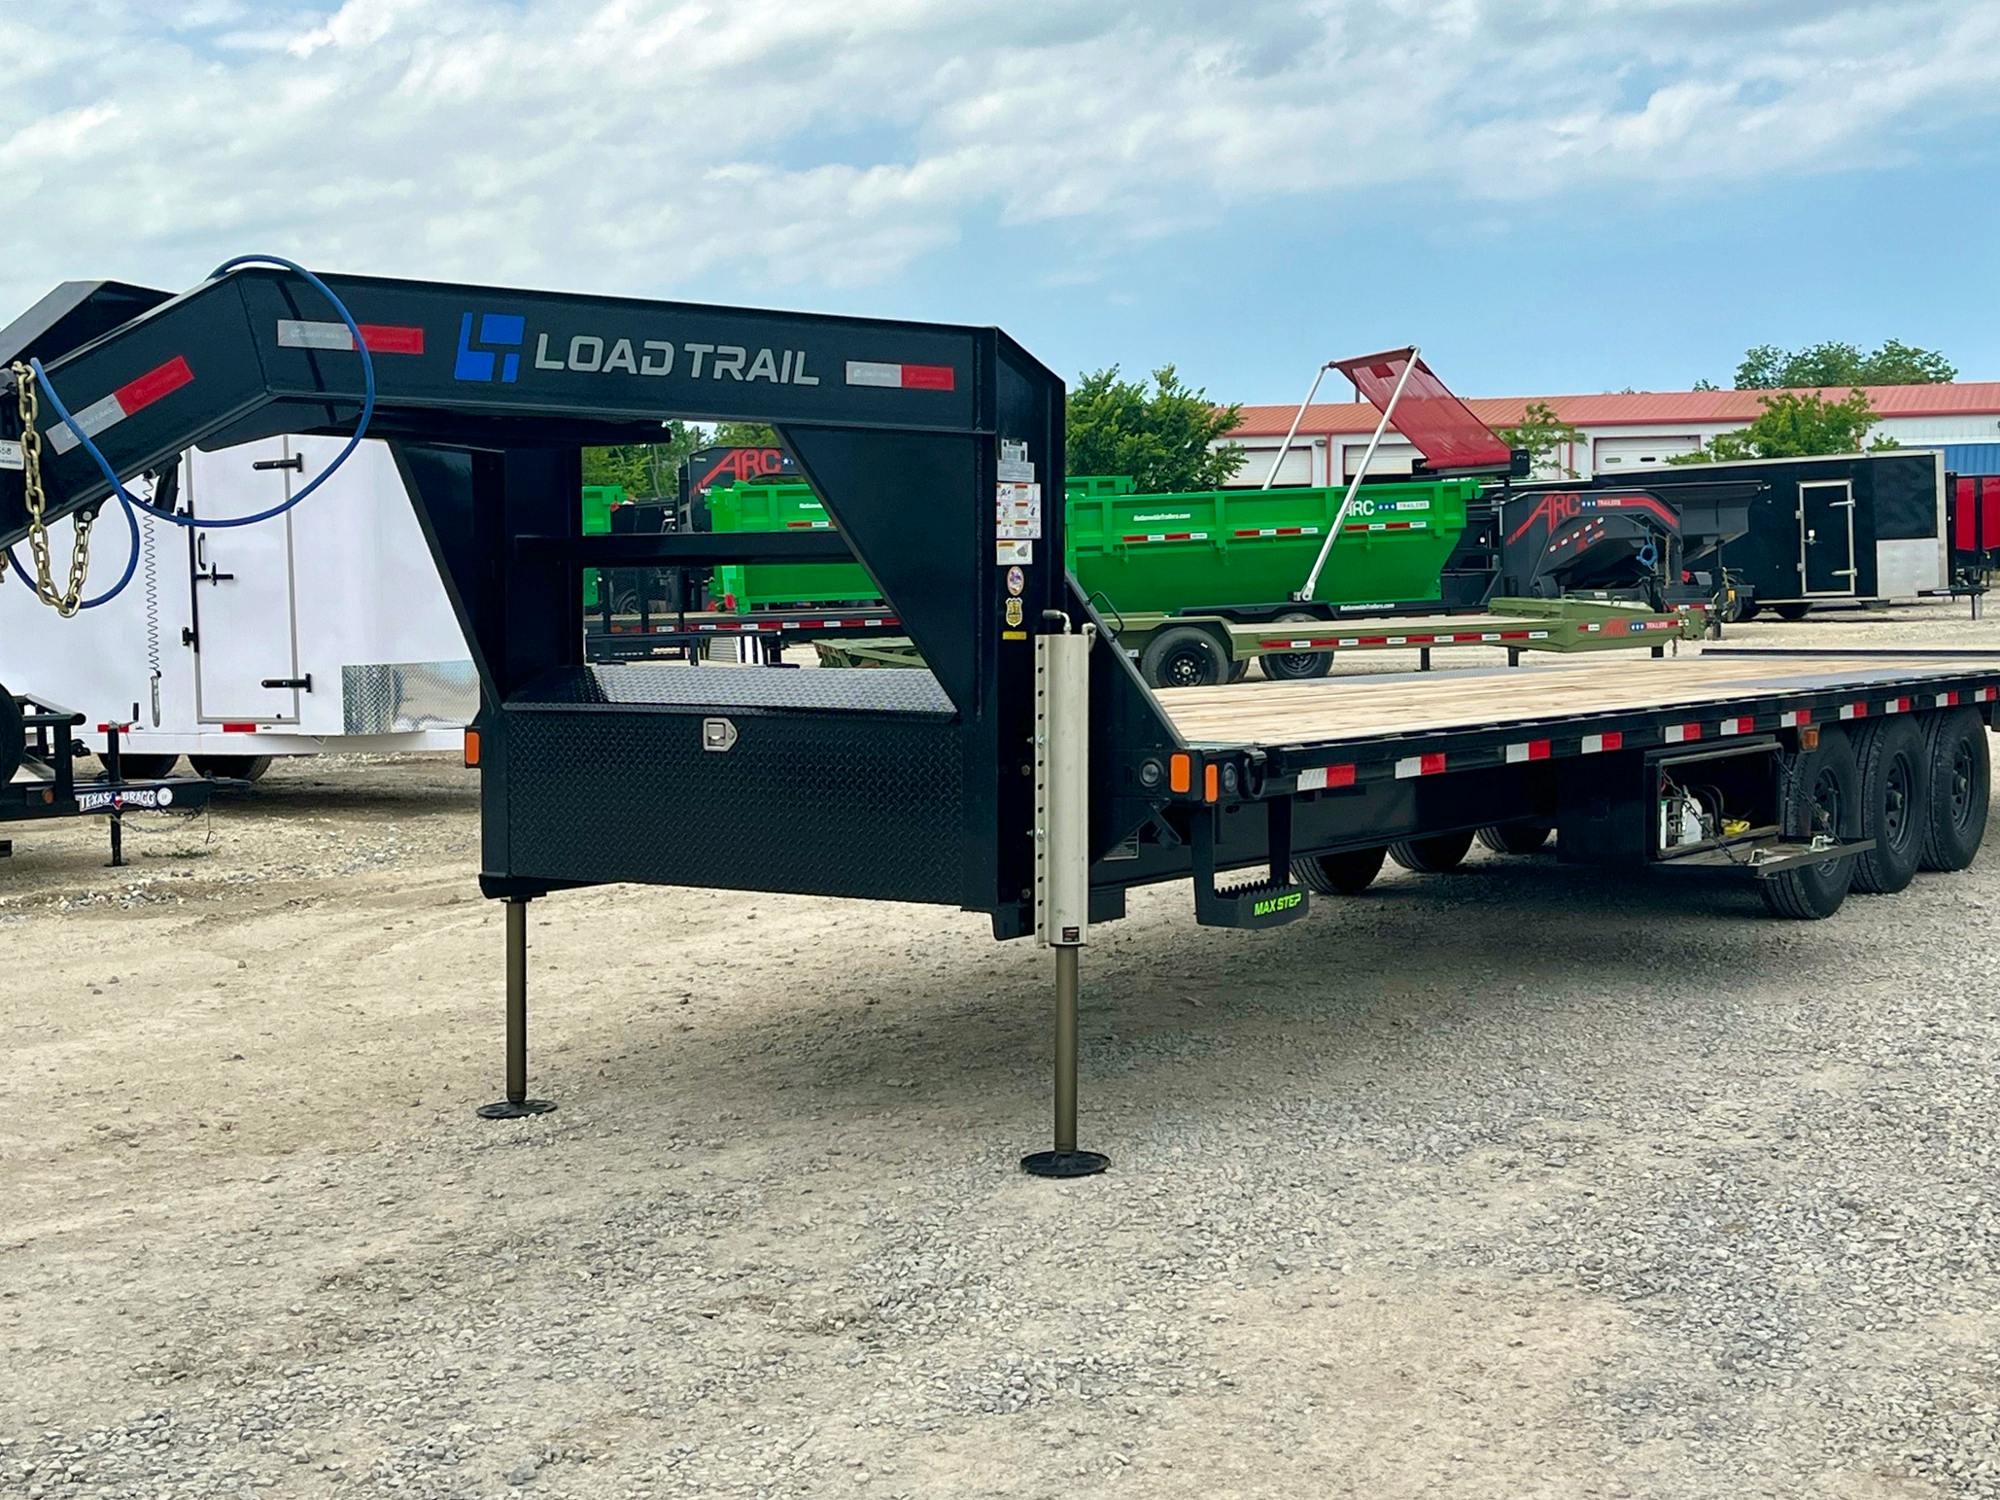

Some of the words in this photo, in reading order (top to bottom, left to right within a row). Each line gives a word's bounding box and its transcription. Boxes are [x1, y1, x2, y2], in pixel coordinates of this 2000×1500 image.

[535, 333, 675, 376] LOAD
[684, 343, 820, 385] TRAIL
[691, 449, 782, 495] ARC
[1507, 494, 1581, 545] ARC
[75, 791, 111, 810] TEXAS
[121, 790, 156, 806] BRAGG
[1254, 900, 1276, 916] MAX
[1277, 893, 1301, 910] STEP
